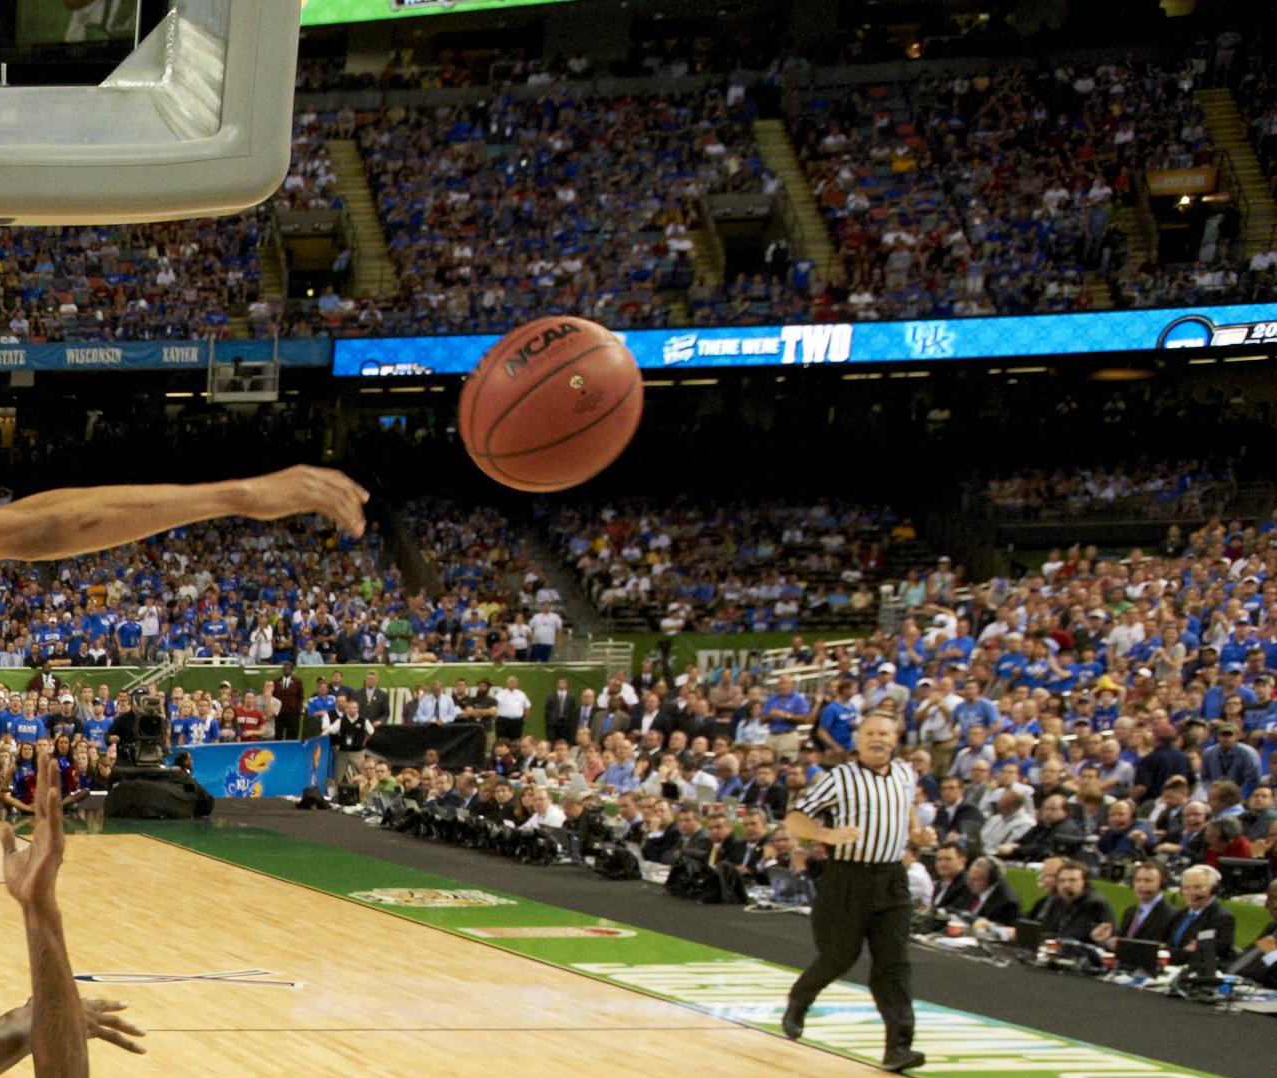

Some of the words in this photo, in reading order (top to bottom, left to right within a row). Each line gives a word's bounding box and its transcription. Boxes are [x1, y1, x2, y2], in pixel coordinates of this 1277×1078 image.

[65, 347, 122, 365] WISCONSIN
[162, 346, 198, 364] XAVIER
[504, 322, 580, 378] NCAA
[779, 323, 852, 365] TWO
